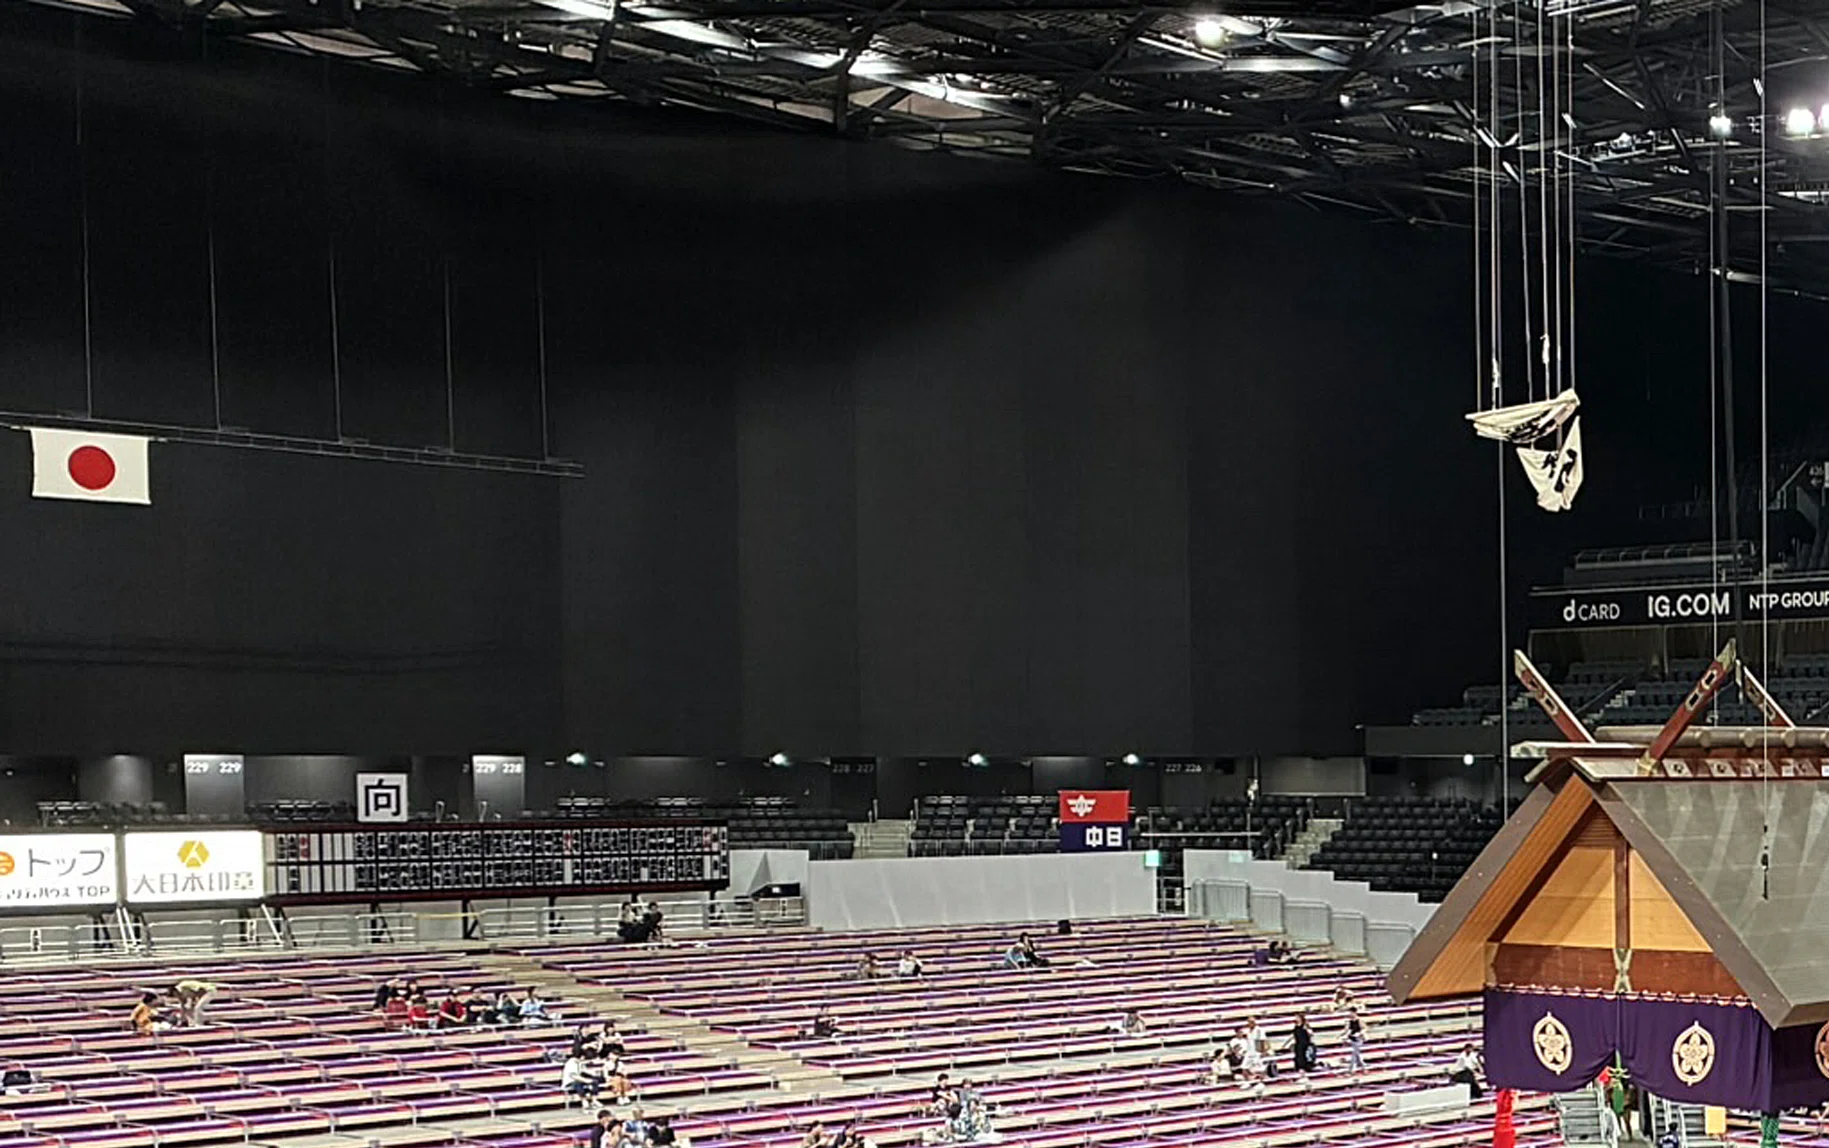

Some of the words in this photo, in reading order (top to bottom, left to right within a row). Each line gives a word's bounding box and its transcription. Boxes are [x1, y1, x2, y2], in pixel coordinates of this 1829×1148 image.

[1578, 603, 1620, 621] CARD
[1648, 592, 1730, 618] IG.COM
[1749, 594, 1780, 610] NTP
[364, 778, 400, 816] 向
[1086, 825, 1123, 847] 中日
[28, 847, 110, 878] トップ
[77, 885, 110, 898] TOP
